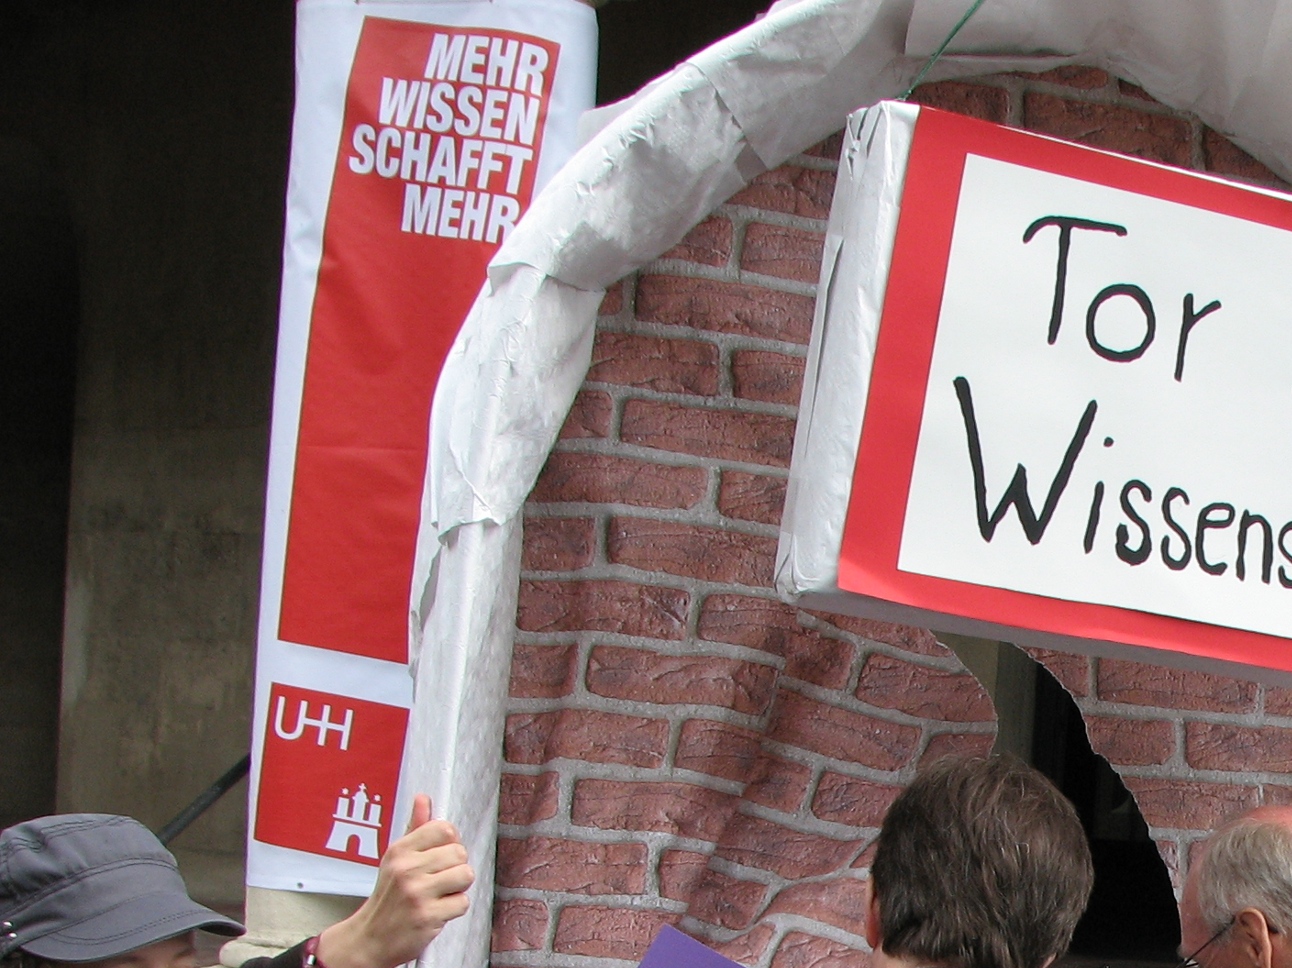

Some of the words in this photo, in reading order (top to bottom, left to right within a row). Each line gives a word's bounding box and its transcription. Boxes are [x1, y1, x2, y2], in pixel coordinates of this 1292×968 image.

[424, 33, 549, 97] MEHR
[378, 77, 540, 146] WISSEN
[349, 124, 533, 195] SCHAFFT
[401, 183, 521, 244] MEHR
[1022, 215, 1221, 382] Tor
